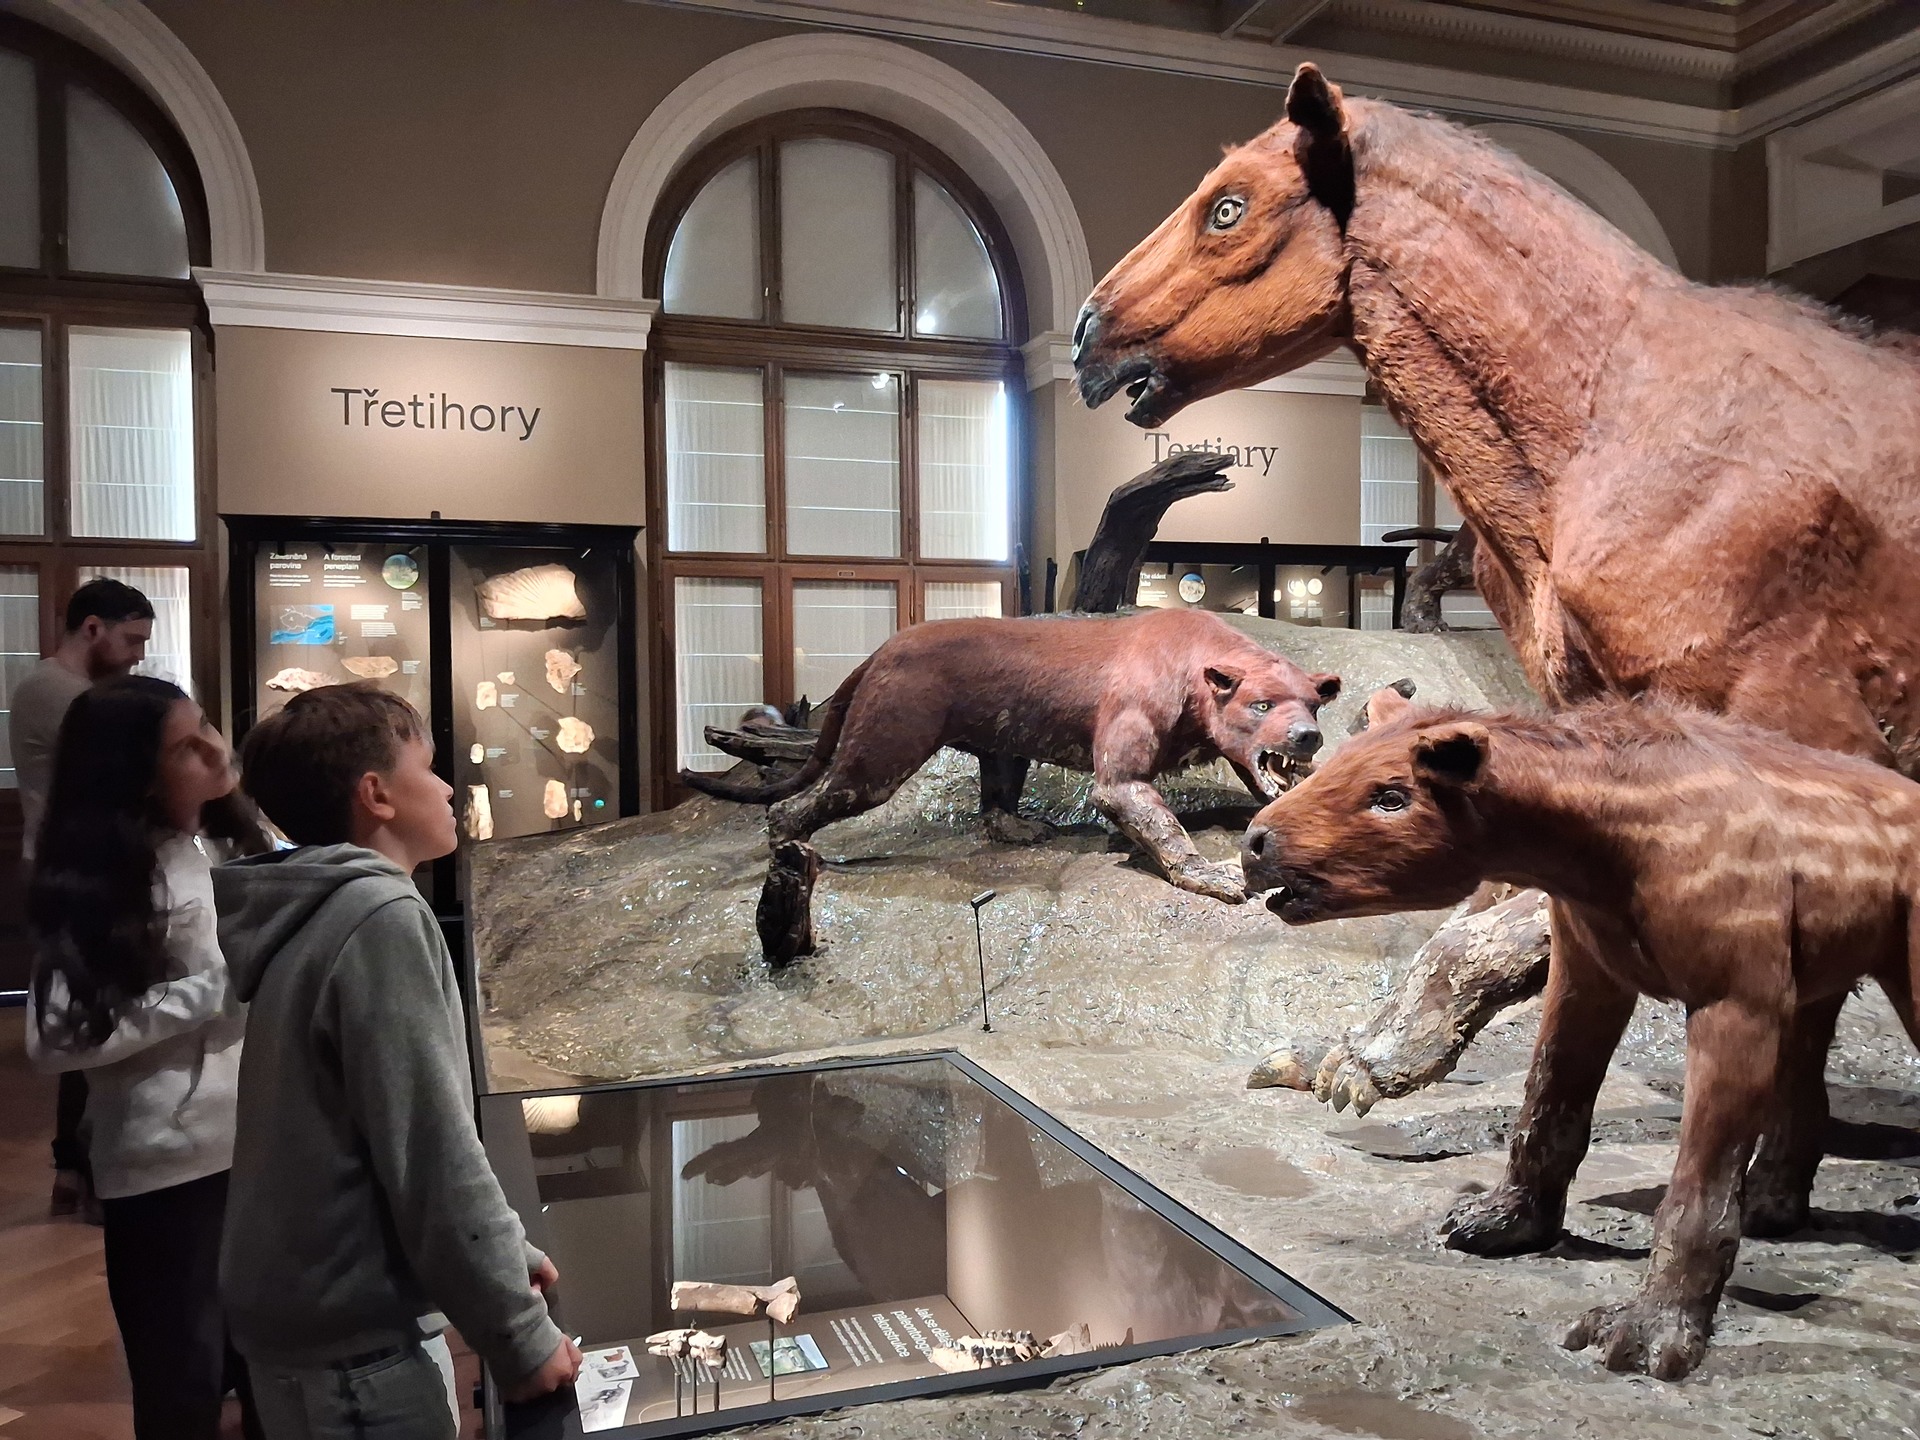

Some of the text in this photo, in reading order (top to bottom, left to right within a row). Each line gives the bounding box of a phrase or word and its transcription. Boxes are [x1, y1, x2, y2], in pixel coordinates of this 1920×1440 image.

[331, 388, 541, 441] Třetihory
[269, 562, 302, 570] parovina
[323, 553, 331, 561] A
[323, 563, 360, 571] peneplain
[914, 1307, 934, 1320] Jak
[924, 1319, 938, 1329] se
[871, 1313, 911, 1358] rekonstrukce
[890, 1310, 933, 1364] paleontologic
